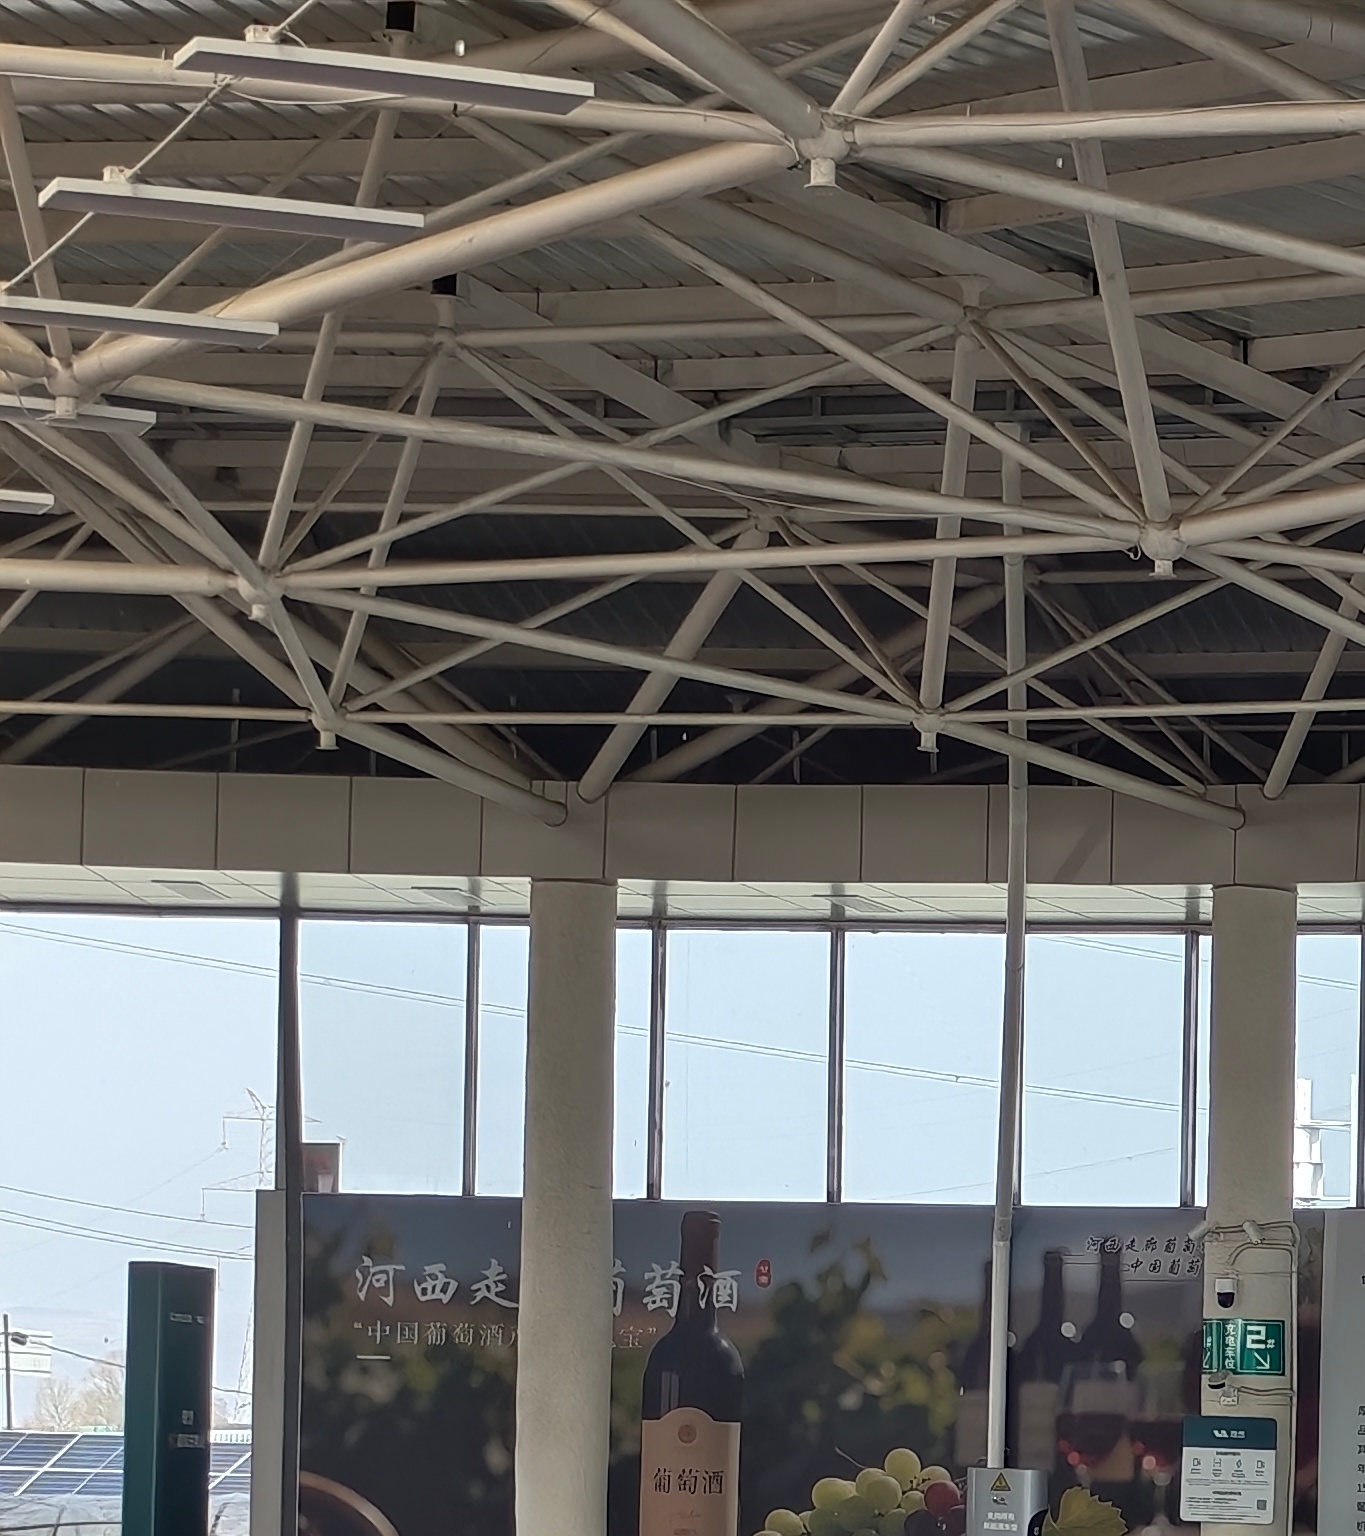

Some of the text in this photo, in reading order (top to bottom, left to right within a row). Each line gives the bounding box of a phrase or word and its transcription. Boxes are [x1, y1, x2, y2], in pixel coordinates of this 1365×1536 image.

[354, 1319, 518, 1346] “中国葡萄酒
[1246, 1325, 1276, 1350] 2#
[1224, 1323, 1238, 1370] 充电车位
[653, 1467, 725, 1495] 葡萄酒
